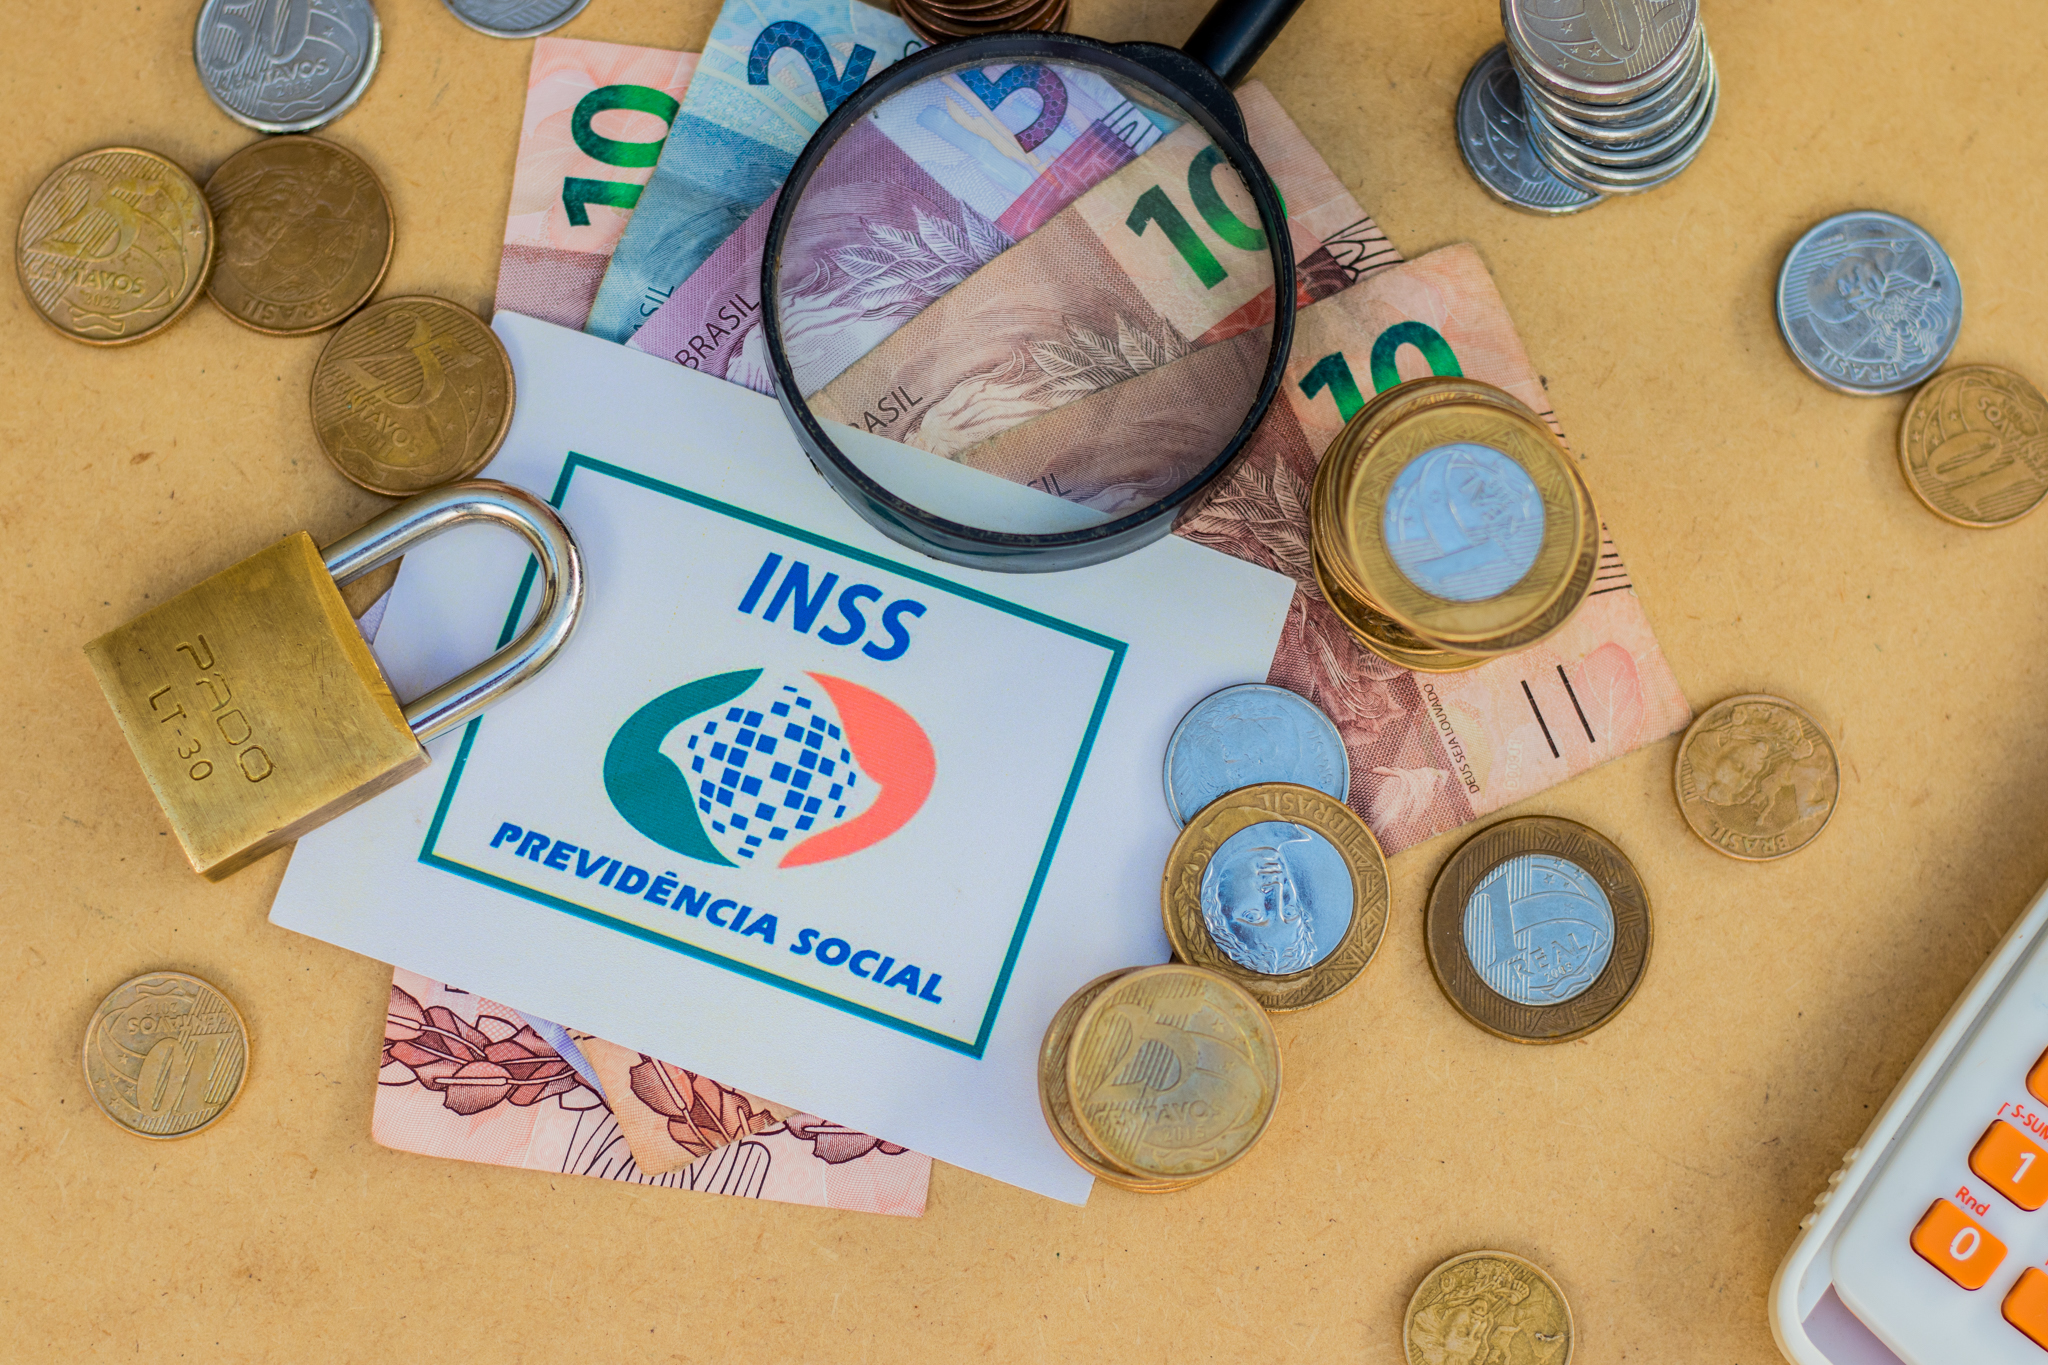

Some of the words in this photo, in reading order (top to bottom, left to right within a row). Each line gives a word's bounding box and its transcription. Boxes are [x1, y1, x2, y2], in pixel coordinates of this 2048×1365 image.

[748, 21, 876, 115] 2
[957, 64, 1068, 154] 5
[563, 85, 680, 226] 10
[26, 170, 165, 262] 25
[1126, 145, 1287, 290] 10
[675, 294, 759, 370] BRASIL
[1298, 321, 1465, 424] 10
[737, 552, 927, 662] INSS
[149, 685, 213, 780] LT-30
[175, 634, 273, 783] PADO
[1424, 683, 1454, 737] LOUVADO
[1448, 737, 1466, 763] SEJA
[1256, 792, 1350, 835] BRASIL
[1459, 764, 1480, 794] DEUS
[1711, 822, 1791, 852] BRASIL
[489, 821, 779, 945] PREVIDÊNCIA
[789, 928, 943, 1004] SOCIAL
[1508, 933, 1591, 982] REAL
[1955, 1186, 1990, 1217] Rnd
[2012, 1152, 2036, 1184] 1
[1949, 1226, 1981, 1261] 0
